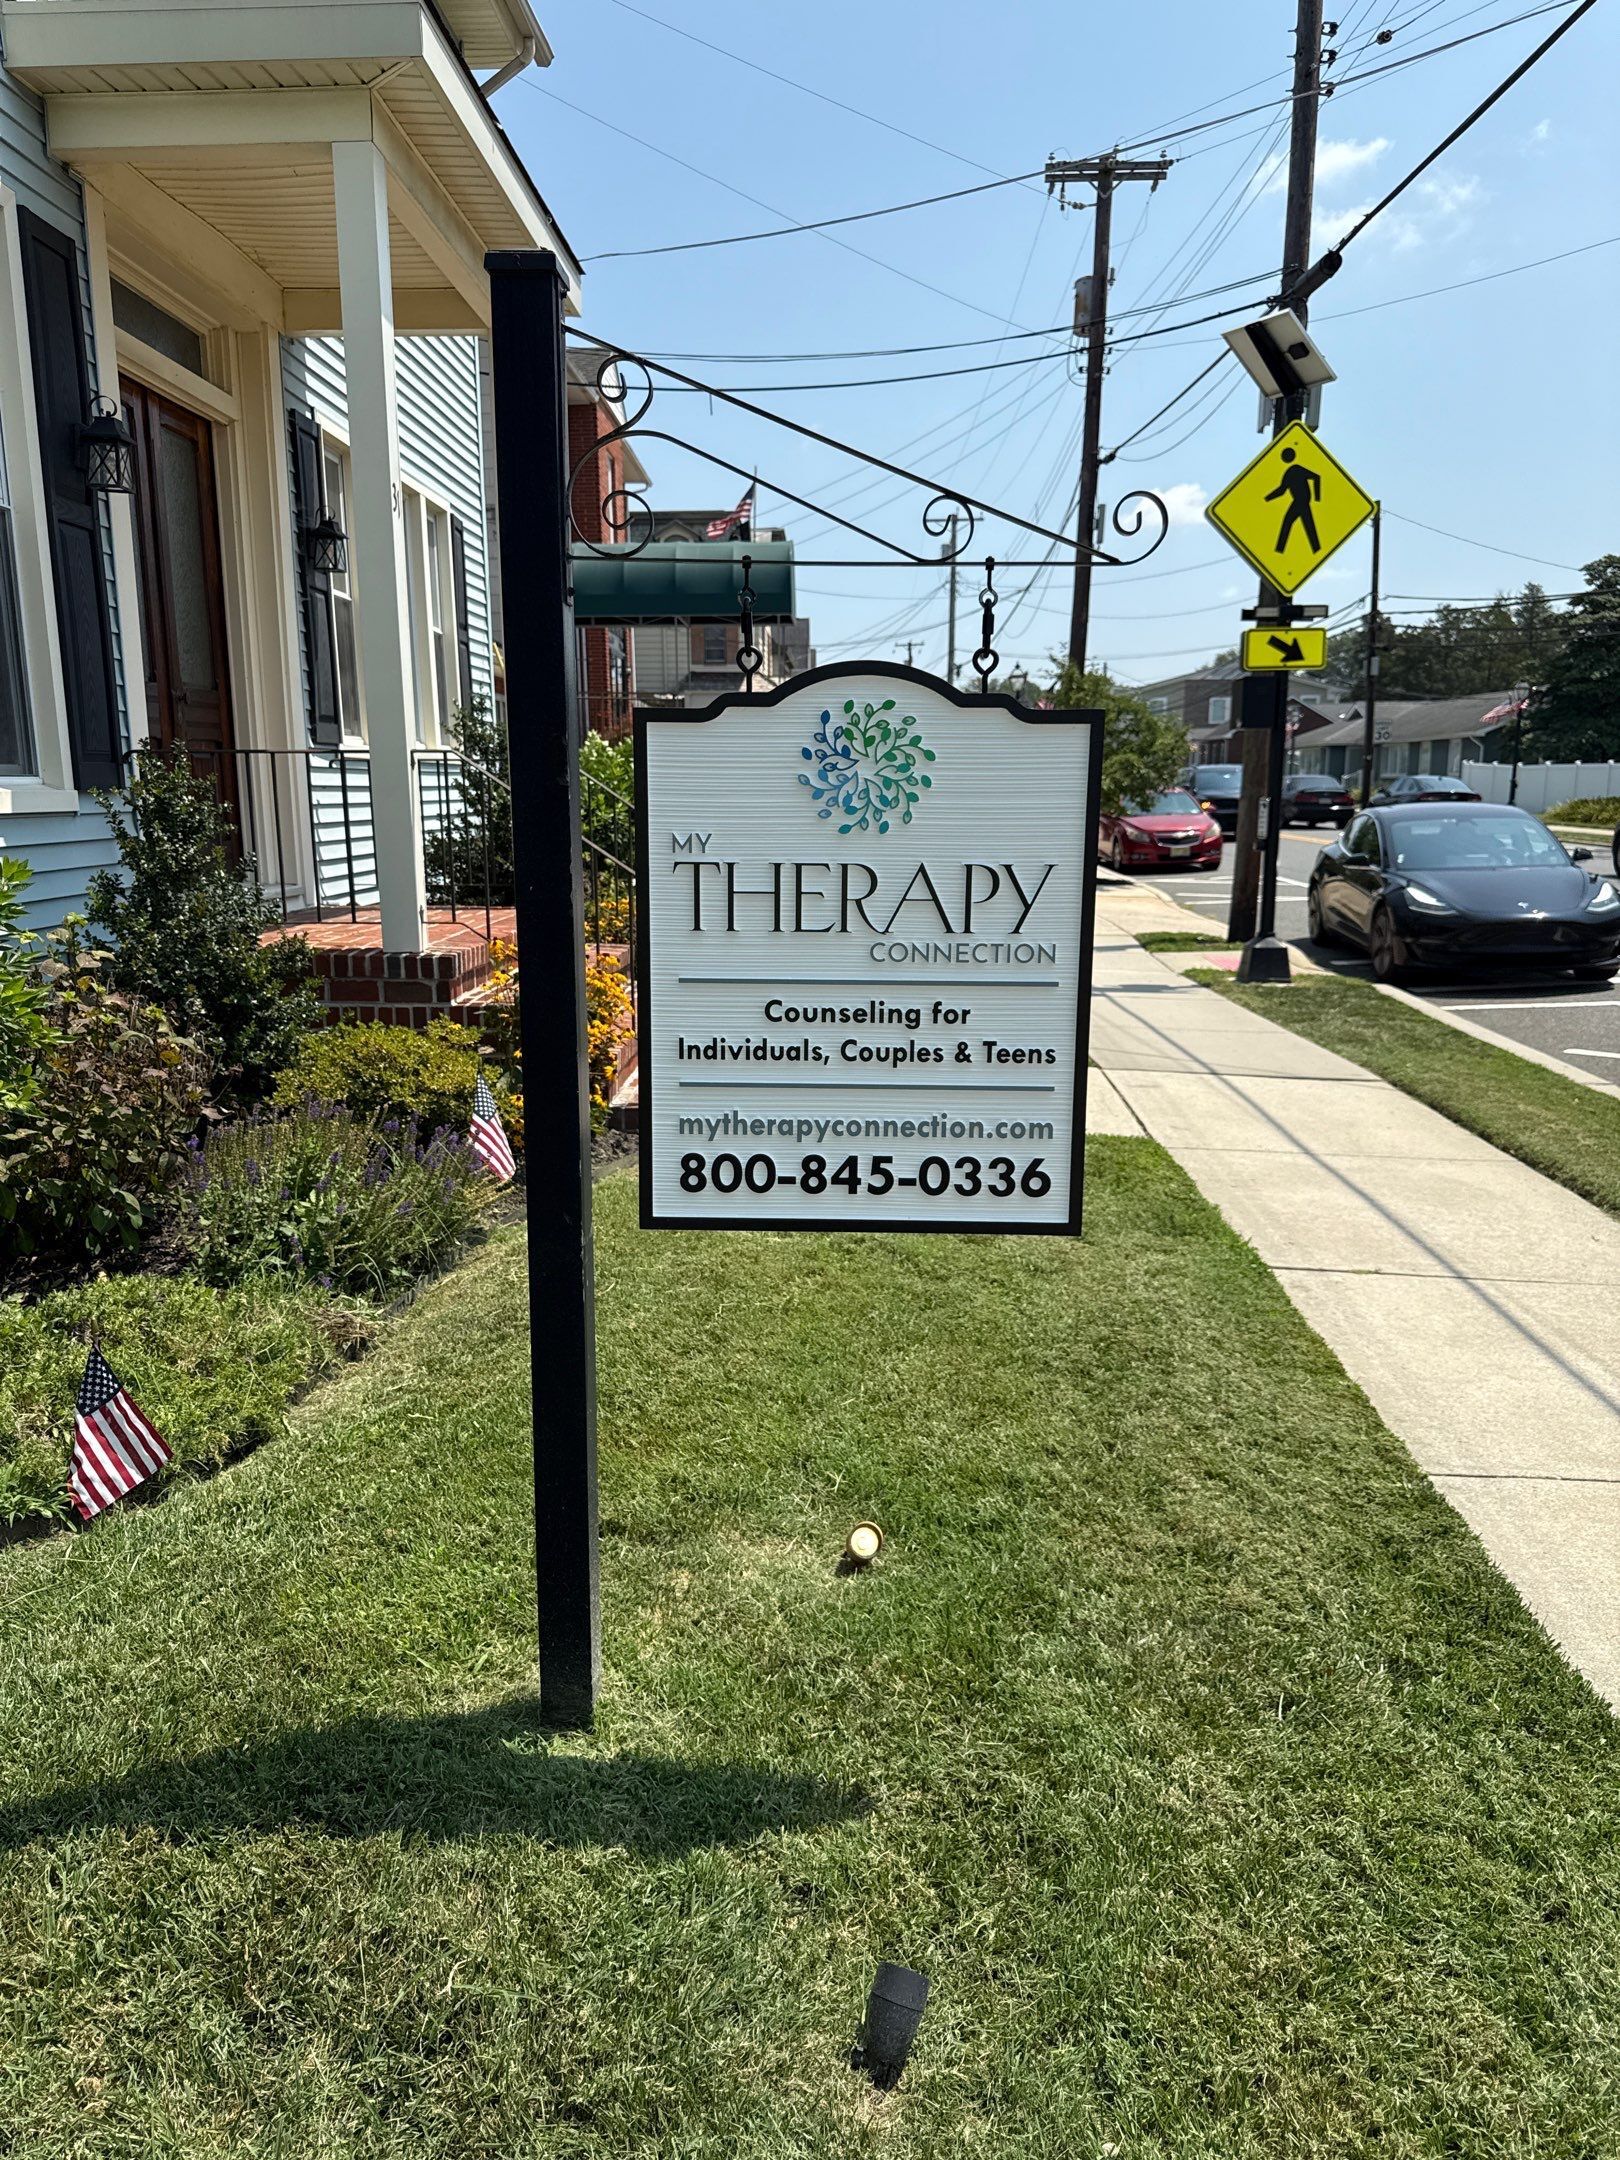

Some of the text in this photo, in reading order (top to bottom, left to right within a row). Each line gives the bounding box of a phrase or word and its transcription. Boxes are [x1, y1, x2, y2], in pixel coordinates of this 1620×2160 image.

[671, 833, 712, 853] MY
[672, 861, 1058, 935] THERAPY
[869, 942, 1057, 964] CONNECTION
[764, 999, 971, 1030] Counseling for
[678, 1037, 1056, 1069] Individuals, Couples & Teens
[678, 1110, 1054, 1143] mytherapyconnection.com
[679, 1152, 1052, 1198] 800-845-0336
